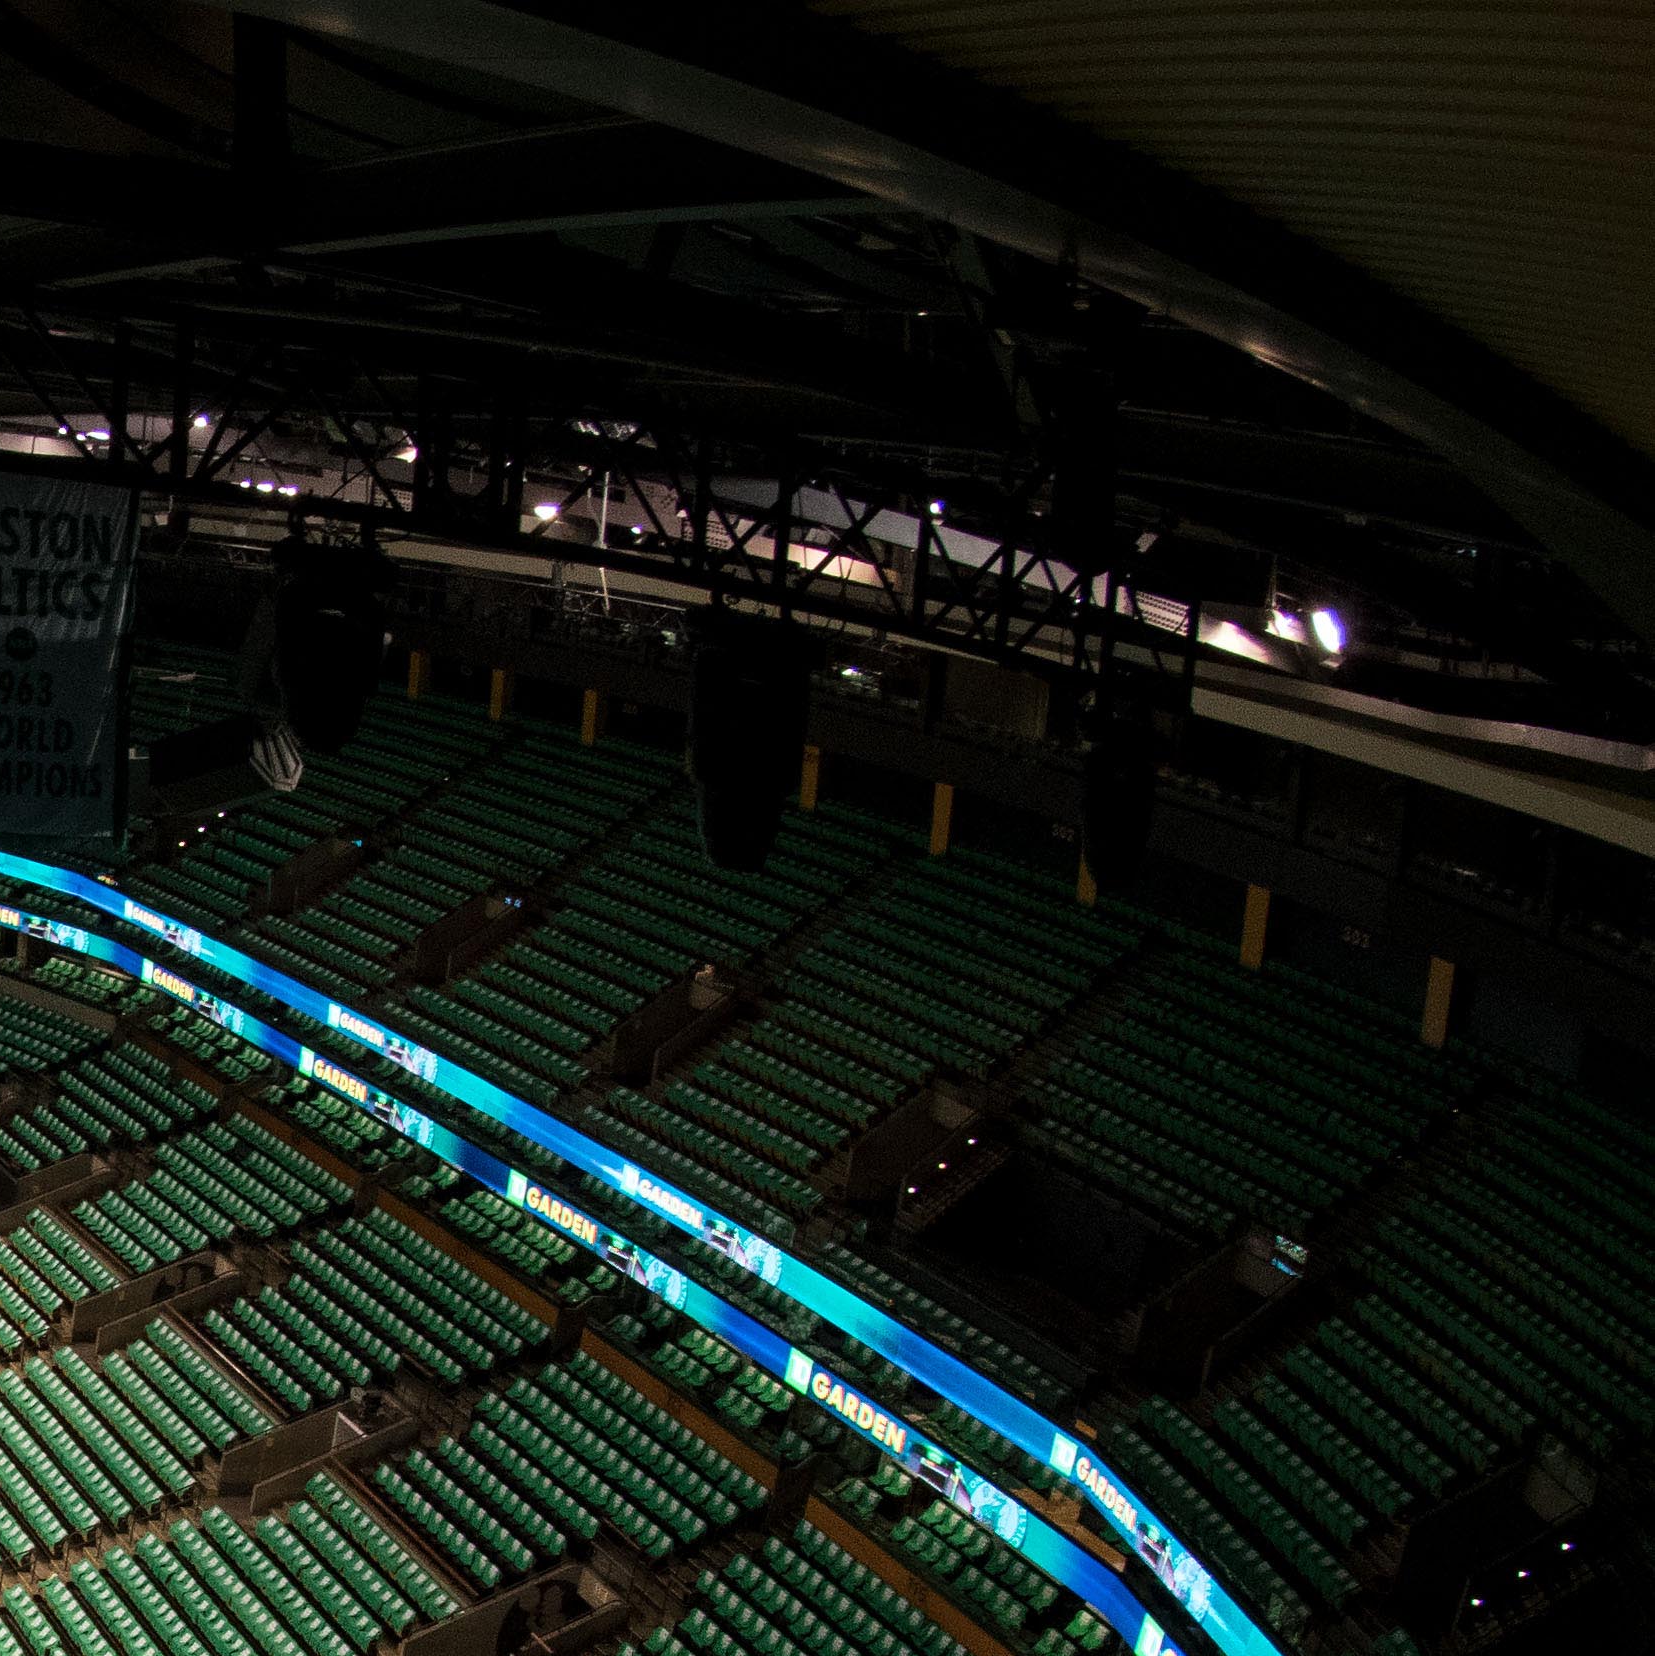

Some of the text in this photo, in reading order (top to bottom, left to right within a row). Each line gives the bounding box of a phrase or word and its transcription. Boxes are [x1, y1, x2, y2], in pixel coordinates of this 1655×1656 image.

[152, 968, 194, 1002] GARDEN
[339, 1013, 385, 1047] GARDEN
[314, 1059, 367, 1102] GARDEN
[526, 1187, 598, 1244] GARDEN
[638, 1179, 703, 1229] GARDEN
[811, 1372, 907, 1454] GARDEN
[1076, 1457, 1138, 1531] GARDEN
